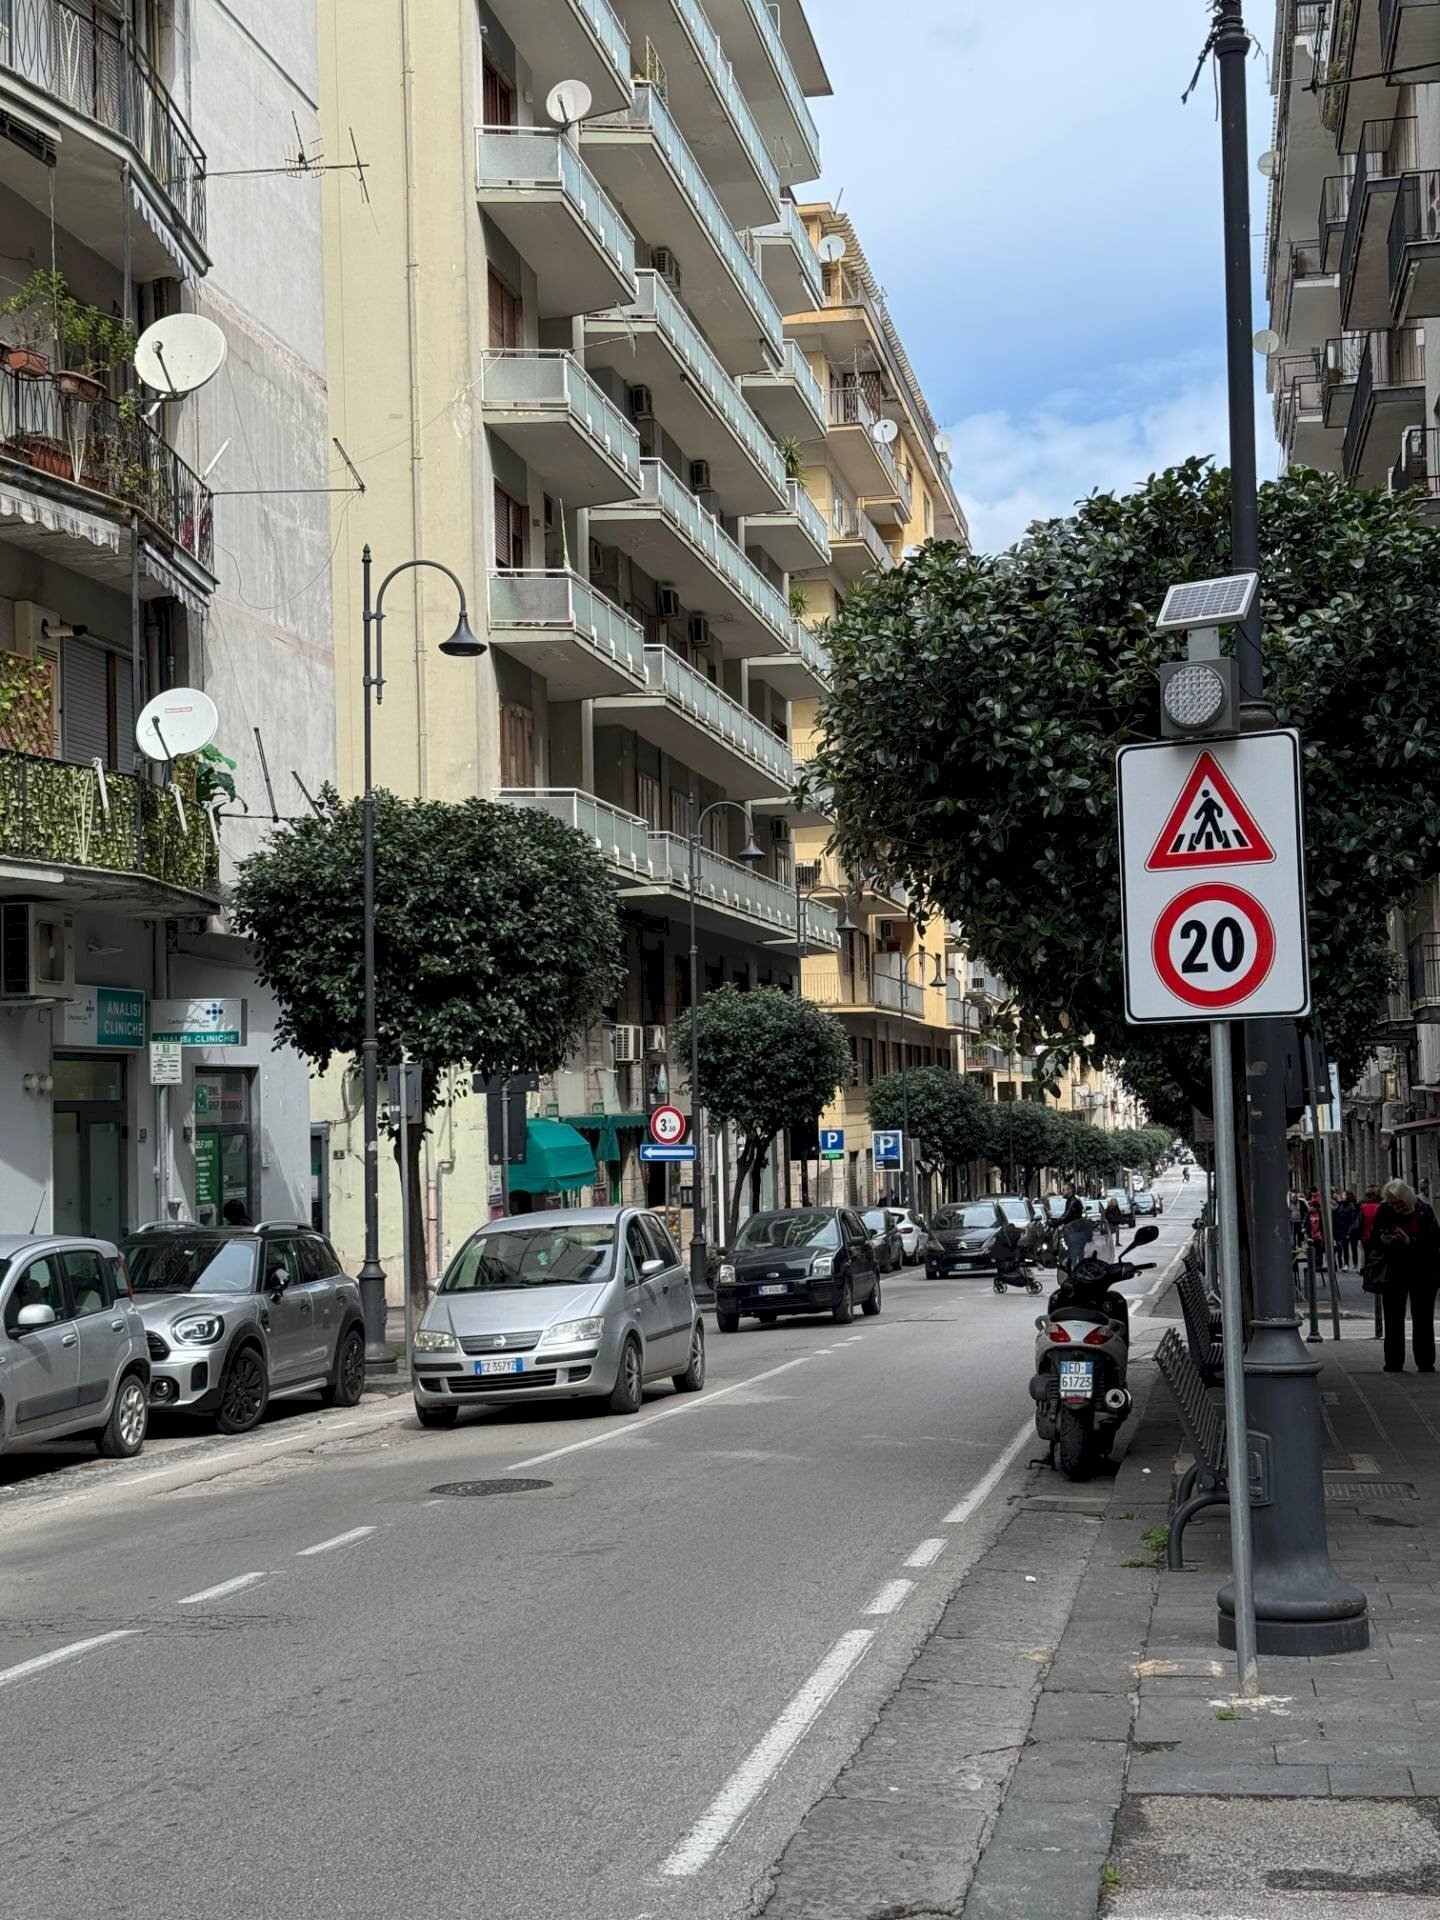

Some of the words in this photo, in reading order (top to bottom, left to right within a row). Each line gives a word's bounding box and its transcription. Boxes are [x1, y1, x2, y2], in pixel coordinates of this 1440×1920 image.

[1180, 916, 1245, 973] 20
[107, 1001, 141, 1017] ANALISI
[104, 1020, 144, 1037] CLINICHE
[194, 1034, 236, 1043] CLINICHE
[827, 1132, 838, 1148] P
[880, 1135, 894, 1155] P
[1069, 1362, 1081, 1373] ED
[1062, 1376, 1091, 1388] 61723
